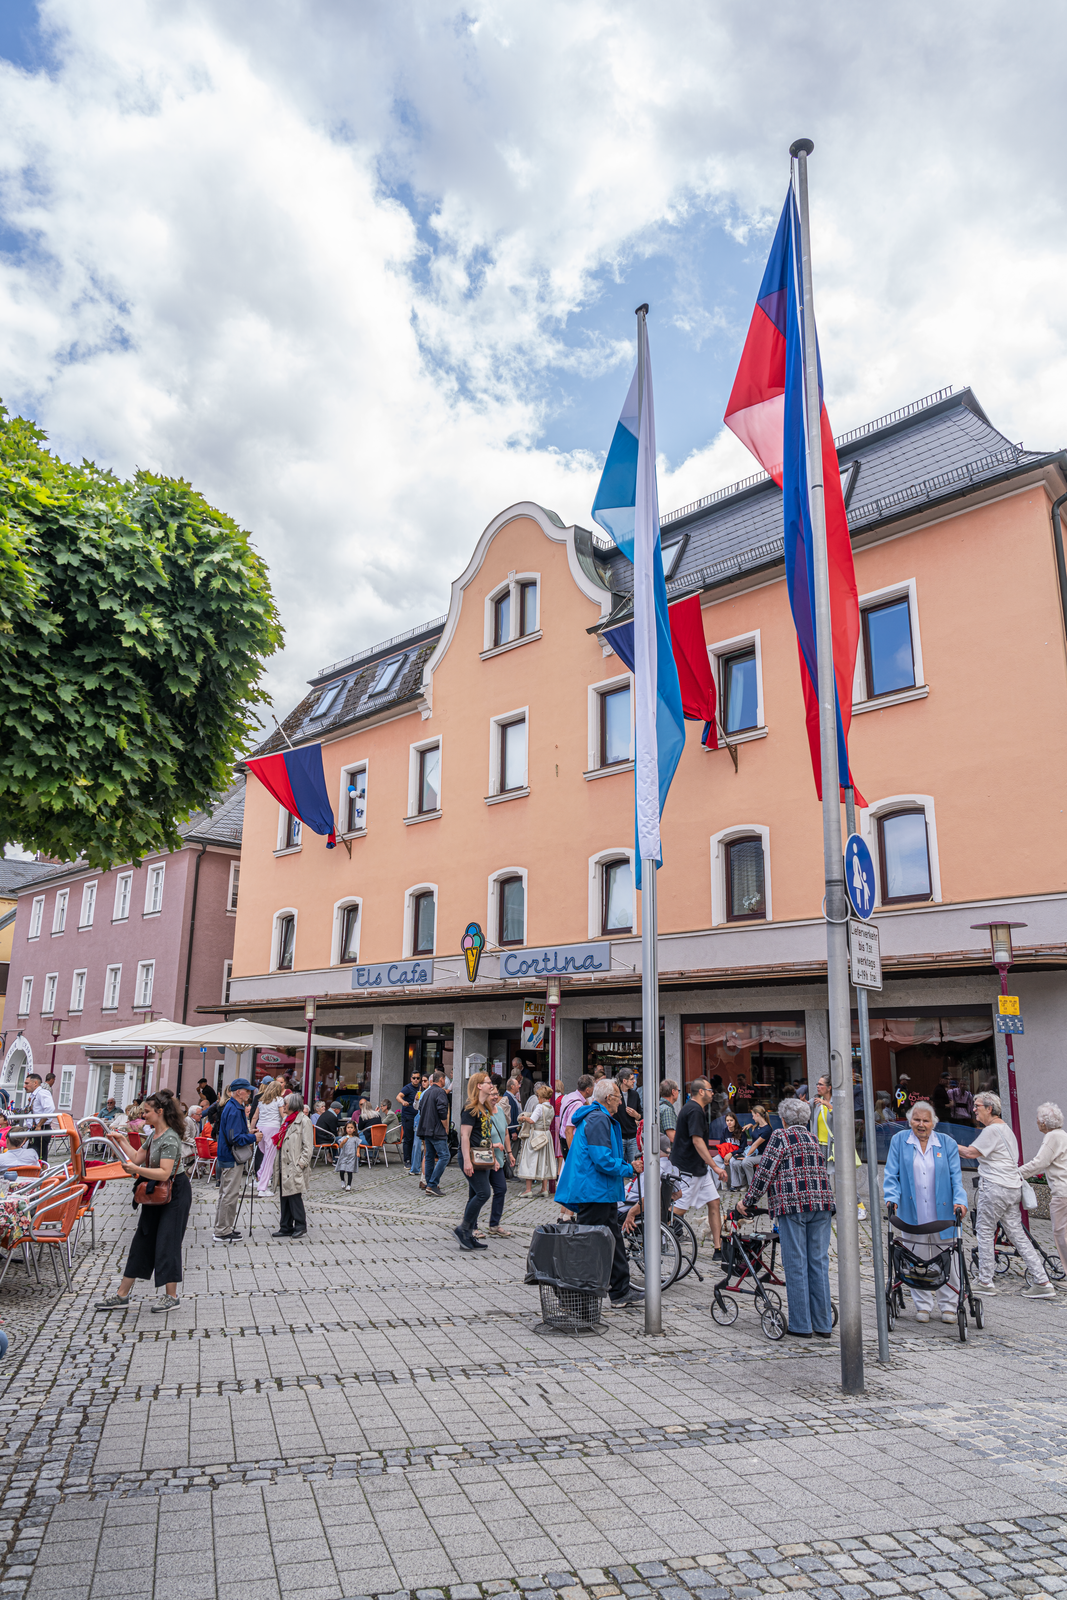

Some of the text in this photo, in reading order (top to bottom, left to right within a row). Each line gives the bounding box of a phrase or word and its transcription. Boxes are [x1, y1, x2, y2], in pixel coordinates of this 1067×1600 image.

[504, 951, 603, 976] Cortina
[857, 957, 876, 970] werktags
[356, 968, 382, 987] Eis
[534, 1016, 544, 1024] EIS
